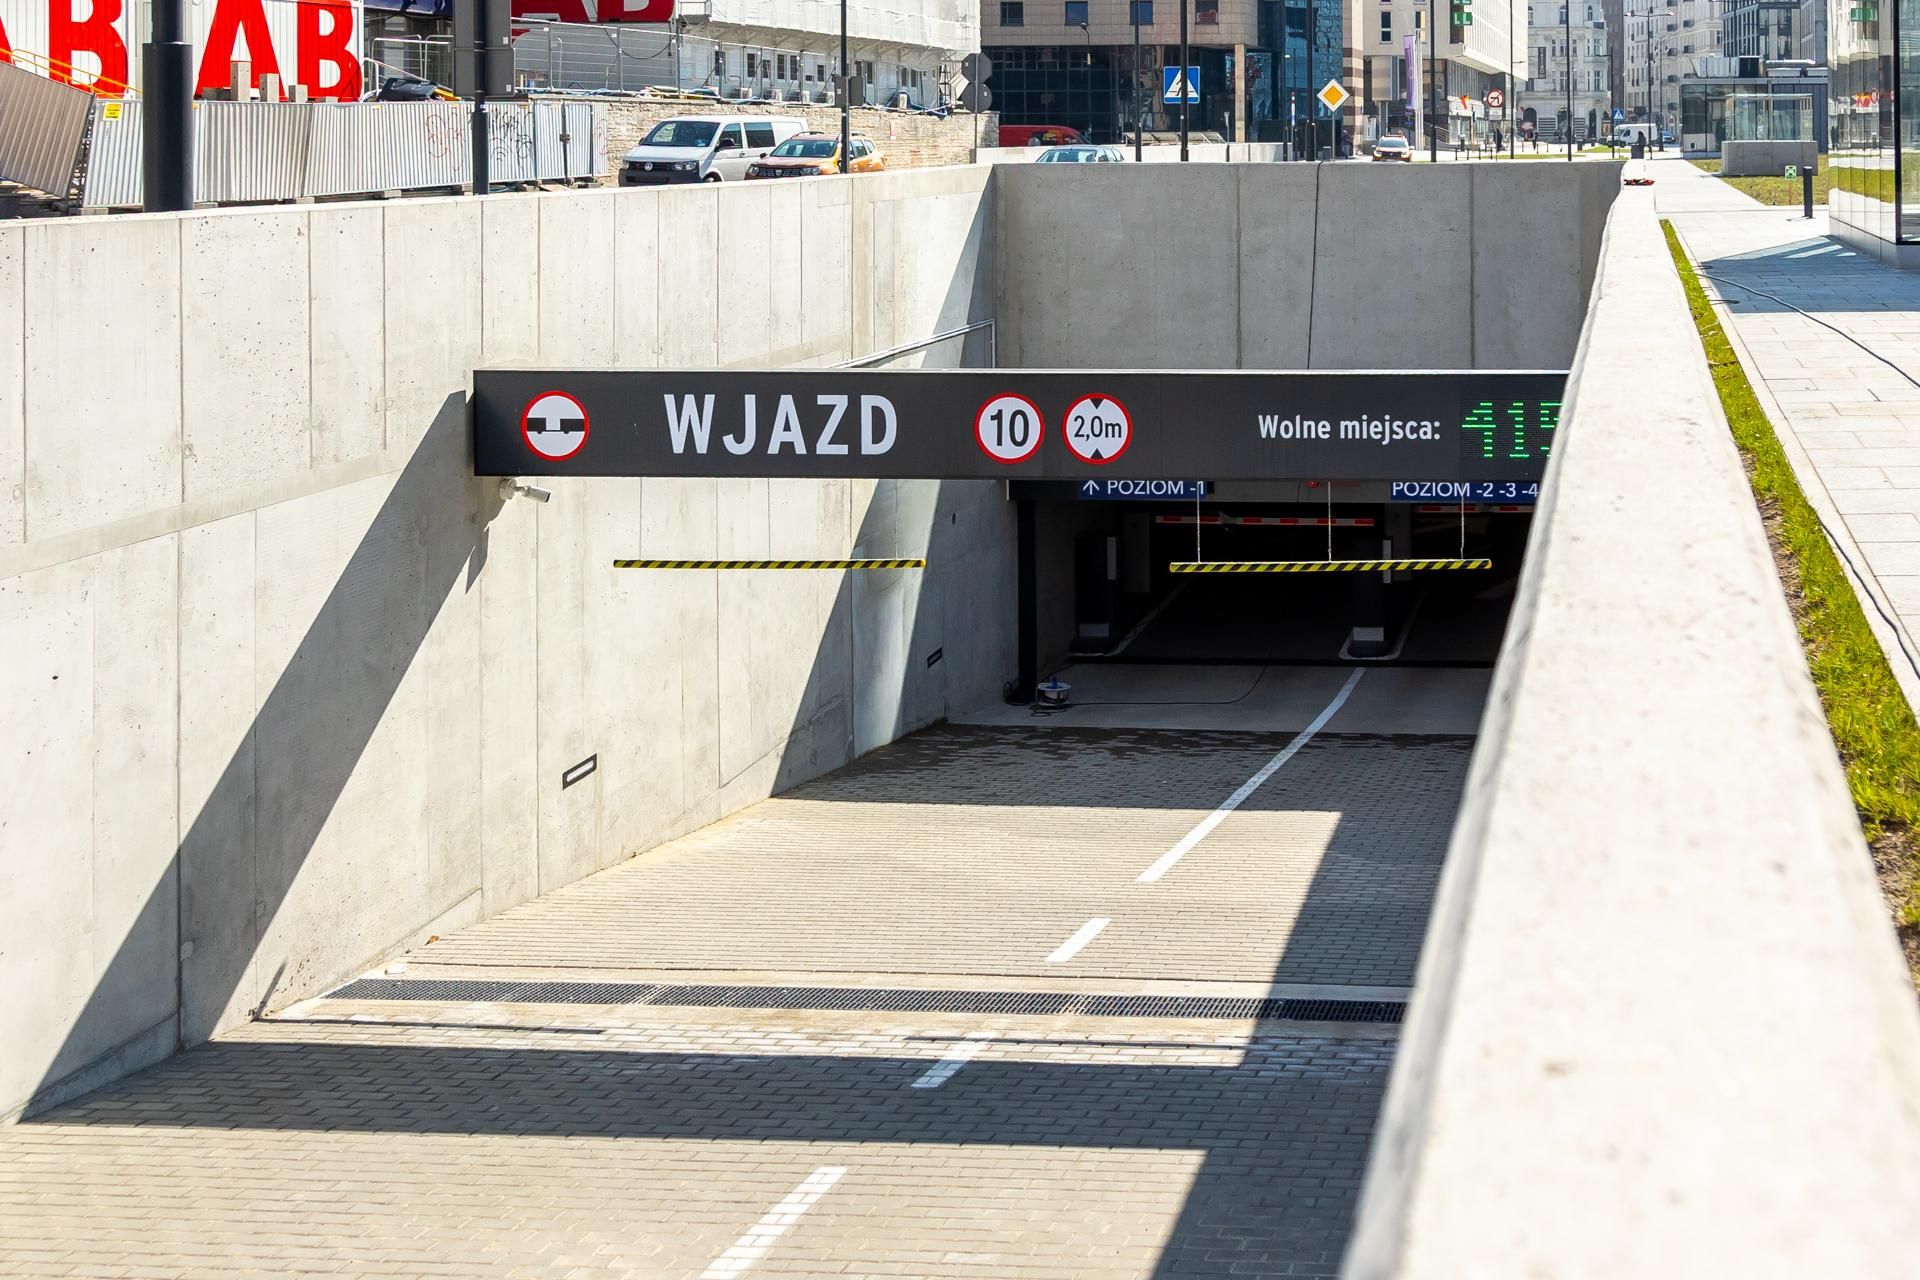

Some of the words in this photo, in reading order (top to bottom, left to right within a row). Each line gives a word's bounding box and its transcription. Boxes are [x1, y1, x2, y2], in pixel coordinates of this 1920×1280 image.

[663, 393, 898, 456] WJAZD
[990, 408, 1030, 447] 10
[1073, 414, 1122, 442] 2,0m
[1258, 414, 1331, 439] Wolne
[1339, 414, 1441, 446] miejsca:
[1107, 480, 1184, 495] POZIOM
[1189, 480, 1204, 495] -1
[1392, 482, 1470, 497] POZIOM
[1476, 482, 1494, 497] -2
[1499, 482, 1517, 498] -3
[1521, 483, 1539, 497] -4
